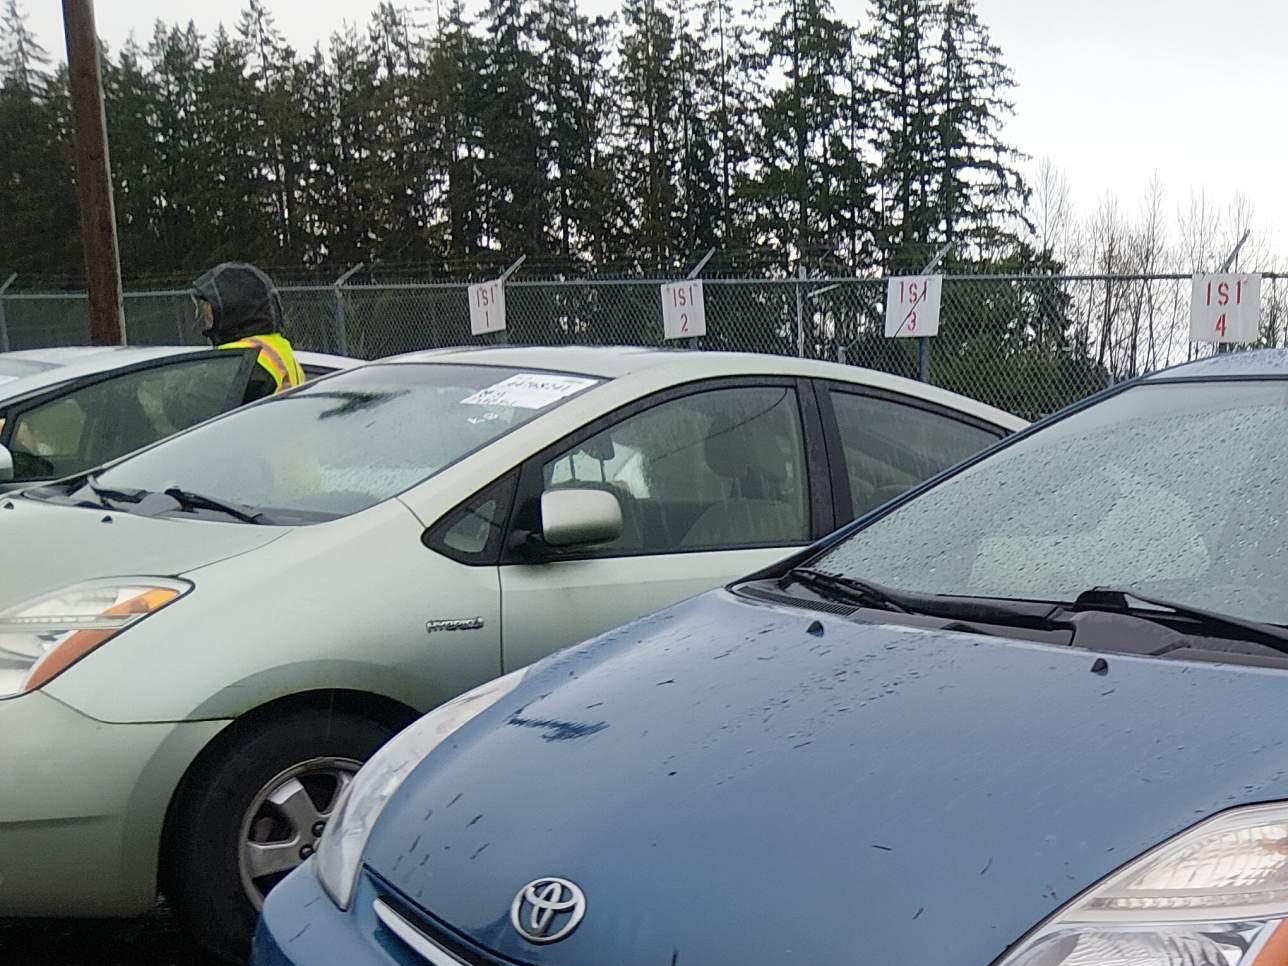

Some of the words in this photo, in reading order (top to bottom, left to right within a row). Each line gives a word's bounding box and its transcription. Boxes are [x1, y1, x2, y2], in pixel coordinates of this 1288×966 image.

[680, 312, 689, 333] 2
[907, 310, 918, 332] 3
[1215, 313, 1227, 337] 4
